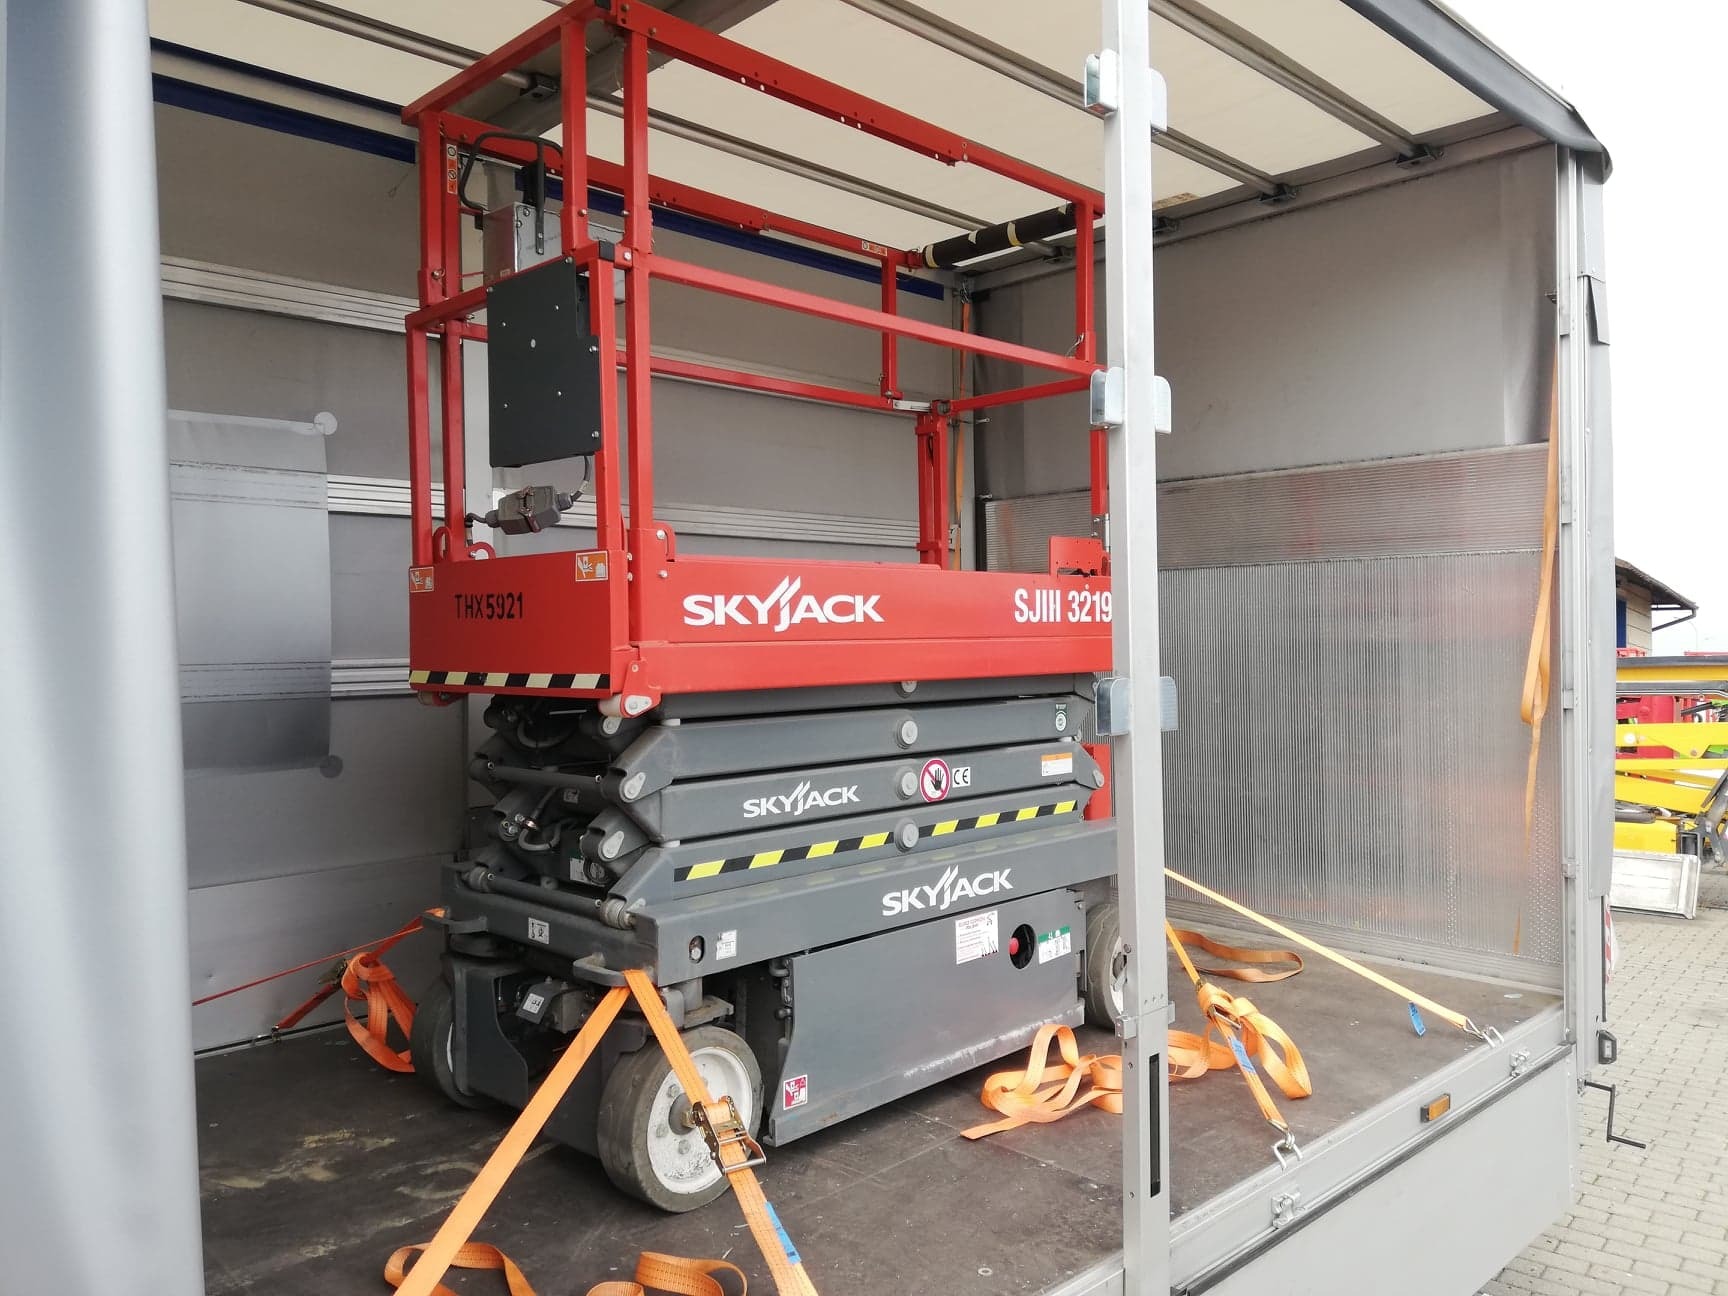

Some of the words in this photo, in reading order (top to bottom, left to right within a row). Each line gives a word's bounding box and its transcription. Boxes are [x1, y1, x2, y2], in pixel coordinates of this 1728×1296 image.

[682, 575, 886, 633] SKYJACK
[1067, 590, 1113, 623] 3219
[953, 768, 969, 785] CE
[742, 780, 861, 818] SKYJACK
[882, 865, 1014, 917] SKYJACK
